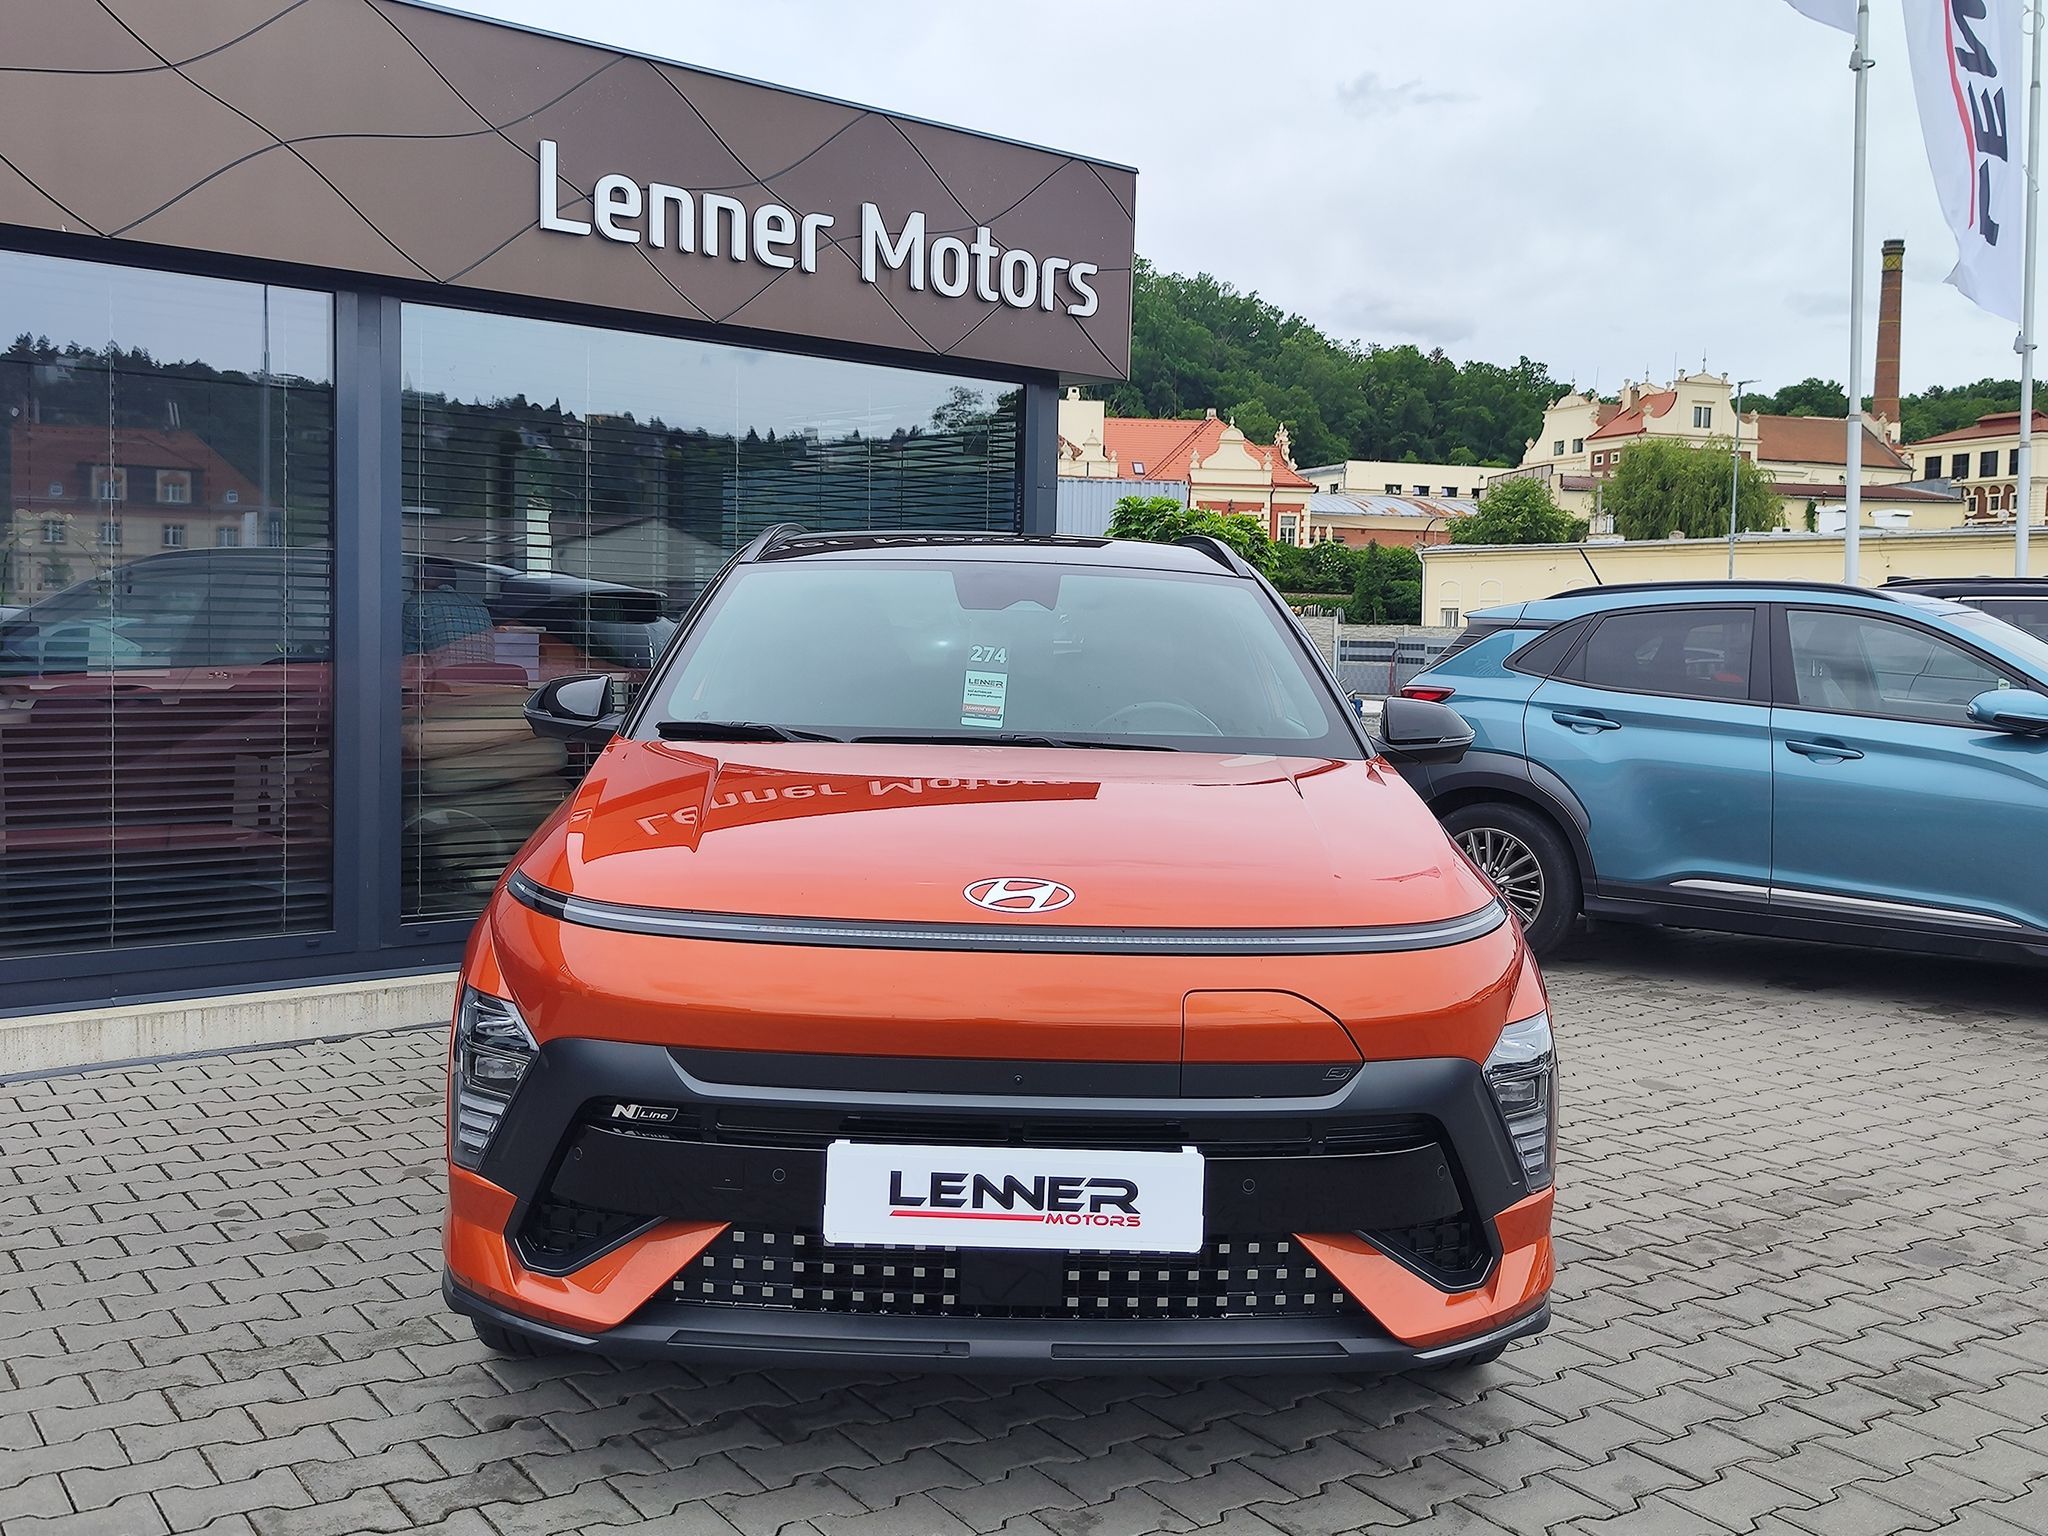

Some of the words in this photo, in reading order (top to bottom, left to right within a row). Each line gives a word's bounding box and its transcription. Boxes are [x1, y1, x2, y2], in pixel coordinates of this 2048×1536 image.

[540, 139, 834, 273] Lenner
[861, 201, 1100, 318] Motors
[970, 645, 1007, 664] 274
[640, 1110, 669, 1120] Line
[889, 1170, 1141, 1214] LENNER
[1045, 1212, 1141, 1228] MOTORS
